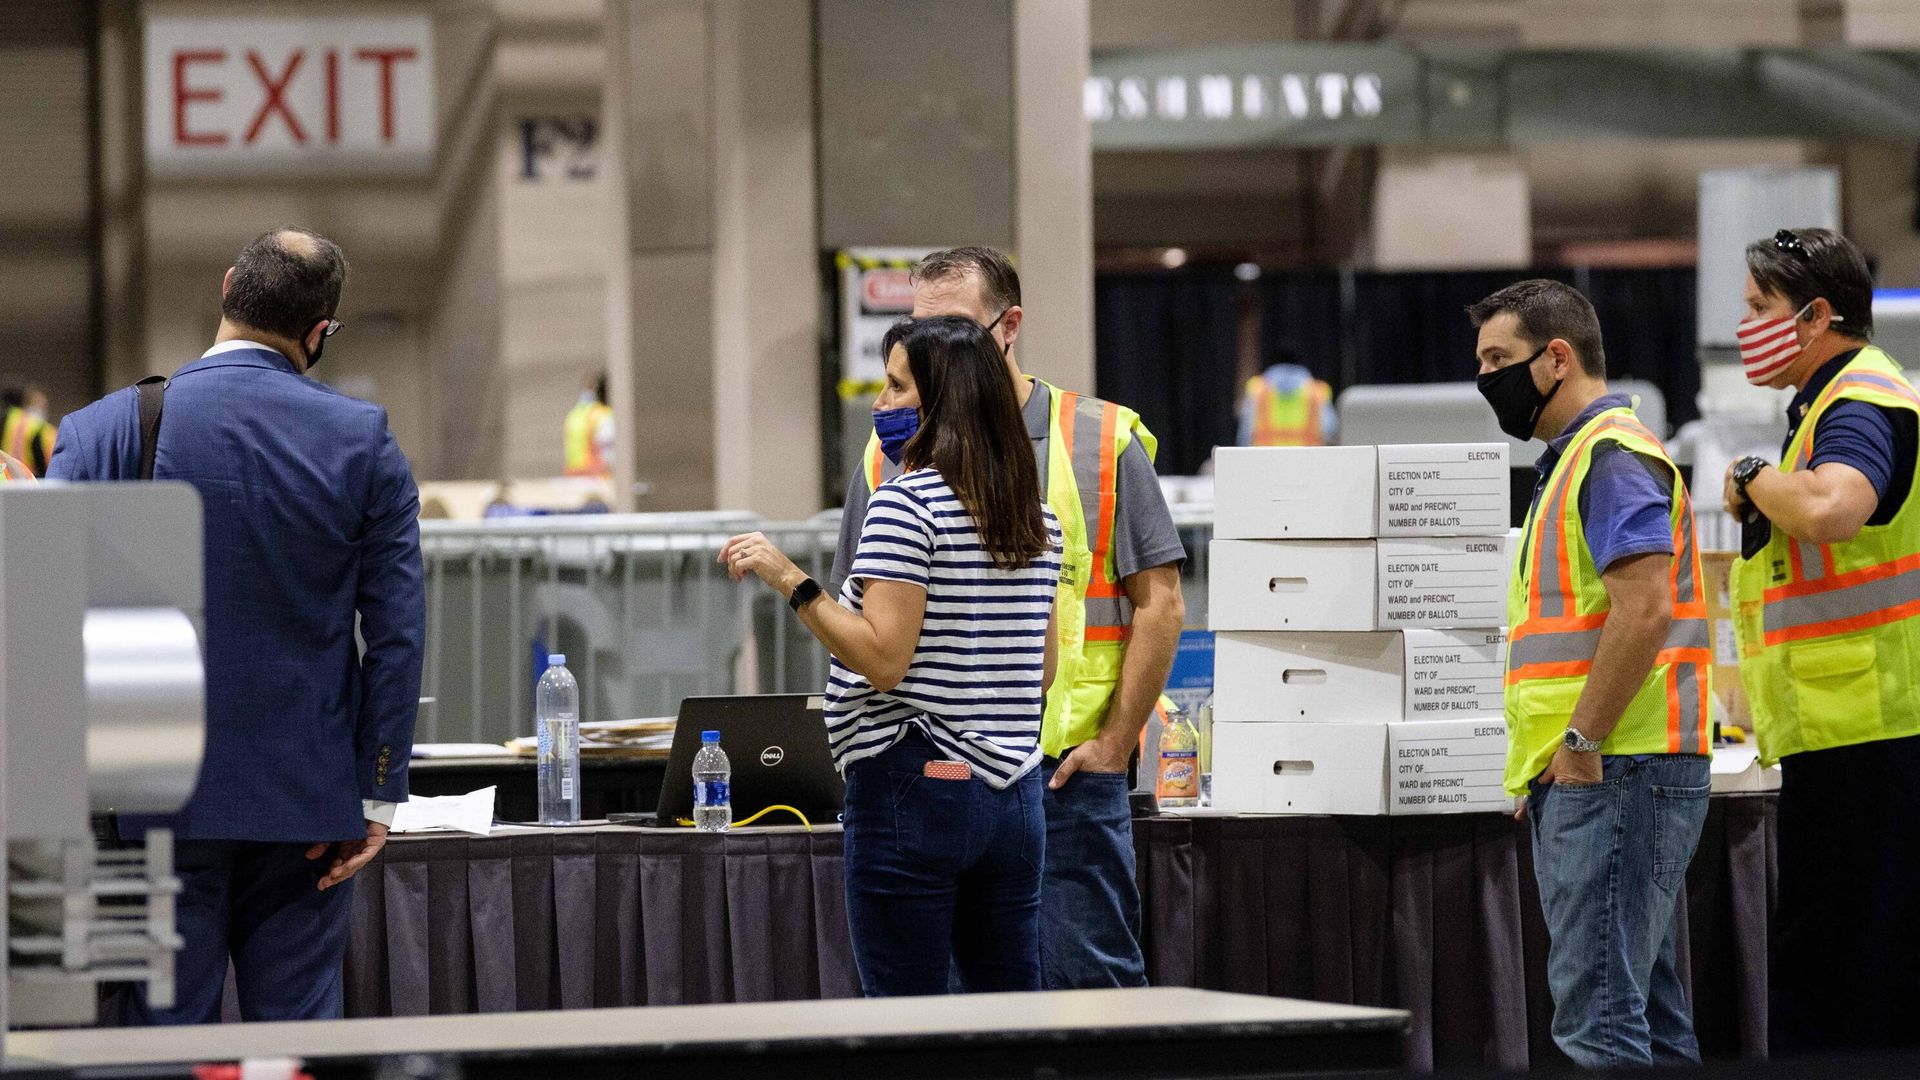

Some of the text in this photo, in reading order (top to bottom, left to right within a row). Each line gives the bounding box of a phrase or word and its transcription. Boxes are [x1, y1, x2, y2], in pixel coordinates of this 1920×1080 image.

[172, 47, 418, 146] EXIT
[1468, 452, 1500, 460] ELECTION
[1389, 471, 1440, 480] ELECTION DATE
[1389, 487, 1415, 496] CITY OF
[1389, 503, 1408, 511] WARD
[1424, 502, 1456, 510] PRECINCT
[1389, 519, 1417, 527] NUMBER
[1430, 518, 1460, 526] BALLOTS
[1466, 544, 1498, 552] ELECTION
[1388, 563, 1439, 572] ELECTION DATE
[1388, 580, 1413, 588] CITY OF
[1388, 596, 1408, 604] WARD
[1423, 595, 1455, 603] PRECINCT
[1388, 610, 1458, 619] NUMBER OF BALLOTS
[1414, 655, 1461, 664] ELECTION DATE
[1414, 671, 1438, 680] CITY OF
[1414, 687, 1432, 695] WARD
[1446, 686, 1476, 694] PRECINCT
[1414, 701, 1479, 711] NUMBER OF BALLOTS
[1475, 728, 1505, 736] ELECTION
[1399, 748, 1448, 758] ELECTION DATE
[1164, 765, 1194, 781] Snapple
[1399, 765, 1424, 773] CITY OF
[1399, 780, 1418, 789] WARD
[1433, 779, 1464, 787] PRECINCT
[1399, 794, 1467, 804] NUMBER OF BALLOTS
